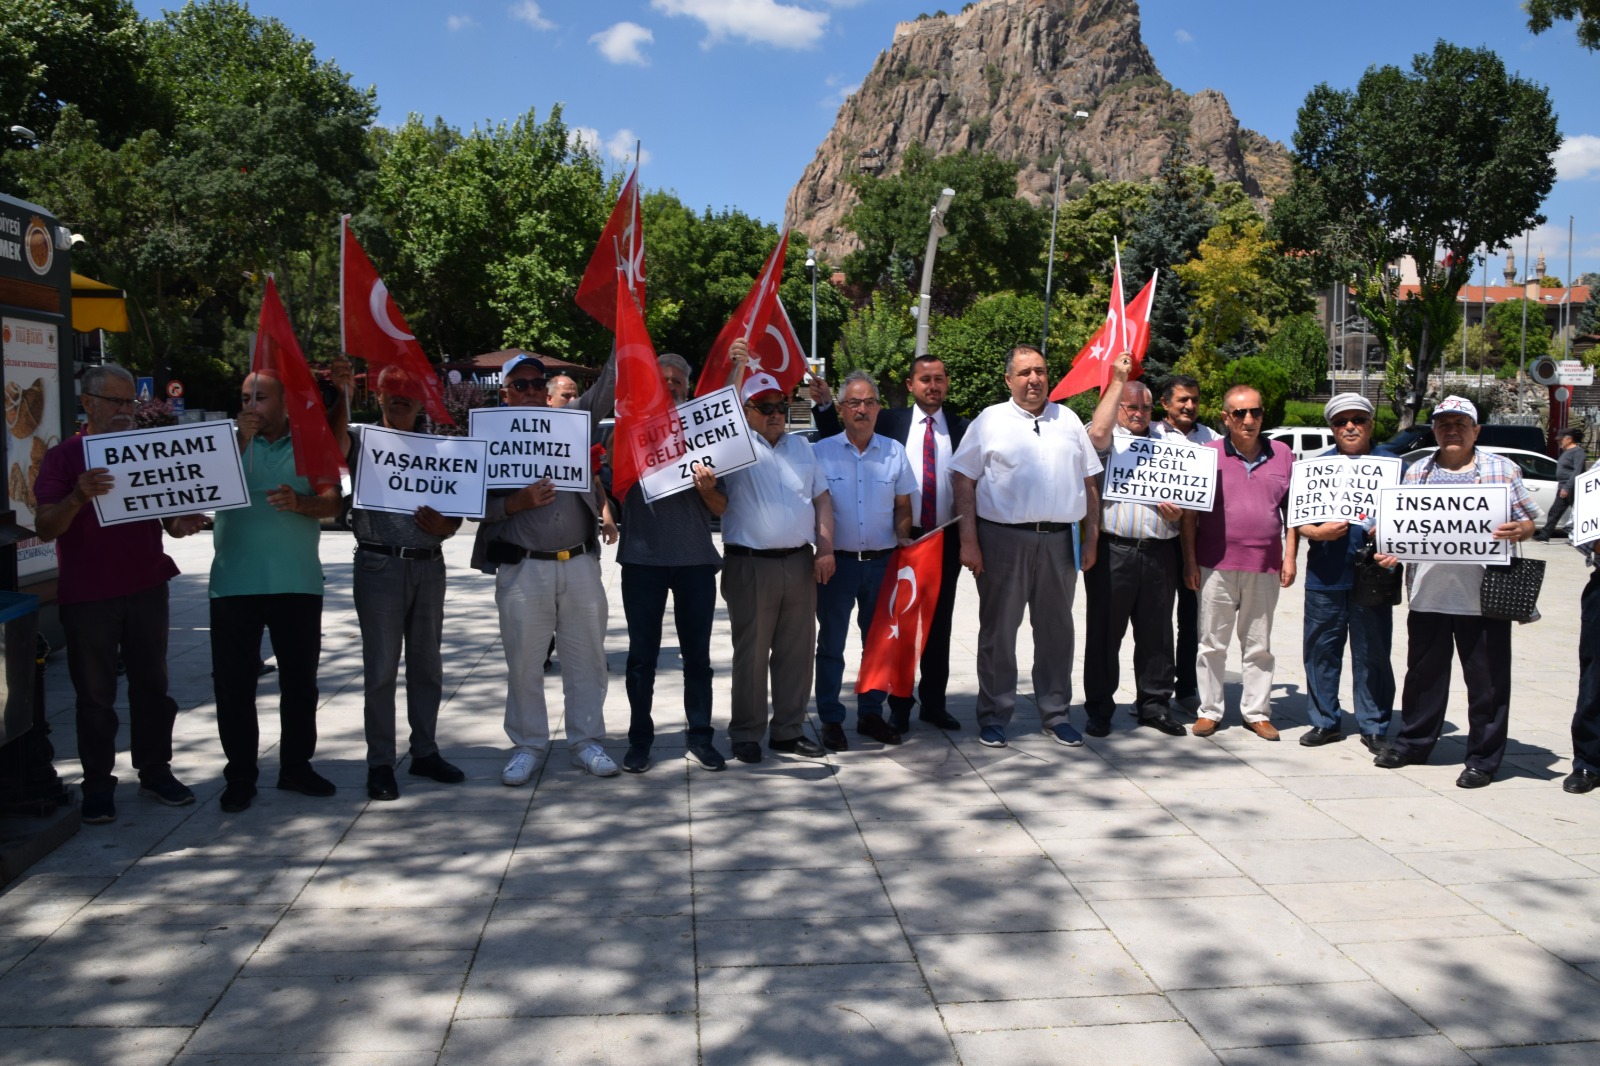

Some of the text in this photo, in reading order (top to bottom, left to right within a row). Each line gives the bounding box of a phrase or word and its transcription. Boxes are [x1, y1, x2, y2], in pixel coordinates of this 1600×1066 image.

[510, 418, 551, 434] ALIN
[637, 398, 734, 448] BÜTÇE BİZE
[105, 435, 217, 465] BAYRAMI
[489, 440, 571, 458] CANIMIZI
[644, 420, 739, 468] GELİNCEMİ
[1129, 441, 1197, 460] SADAKA
[371, 448, 478, 474] YAŞARKEN
[1136, 455, 1188, 472] DEĞİL
[128, 461, 205, 488] ZEHİR
[488, 463, 583, 481] URTULALIM
[1113, 466, 1209, 488] HAKKIMIZI
[1305, 464, 1383, 478] İNSANCA
[388, 471, 458, 495] ÖLDÜK
[1111, 478, 1207, 504] İSTİYORUZ
[1307, 477, 1378, 491] ONURLU
[123, 484, 221, 512] ETTİNİZ
[1295, 490, 1376, 506] BİR YAŞA
[1395, 493, 1490, 511] İNSANCA
[1294, 502, 1377, 520] İSTİYORU
[1393, 519, 1493, 537] YAŞAMAK
[1385, 537, 1501, 555] İSTİYORUZ
